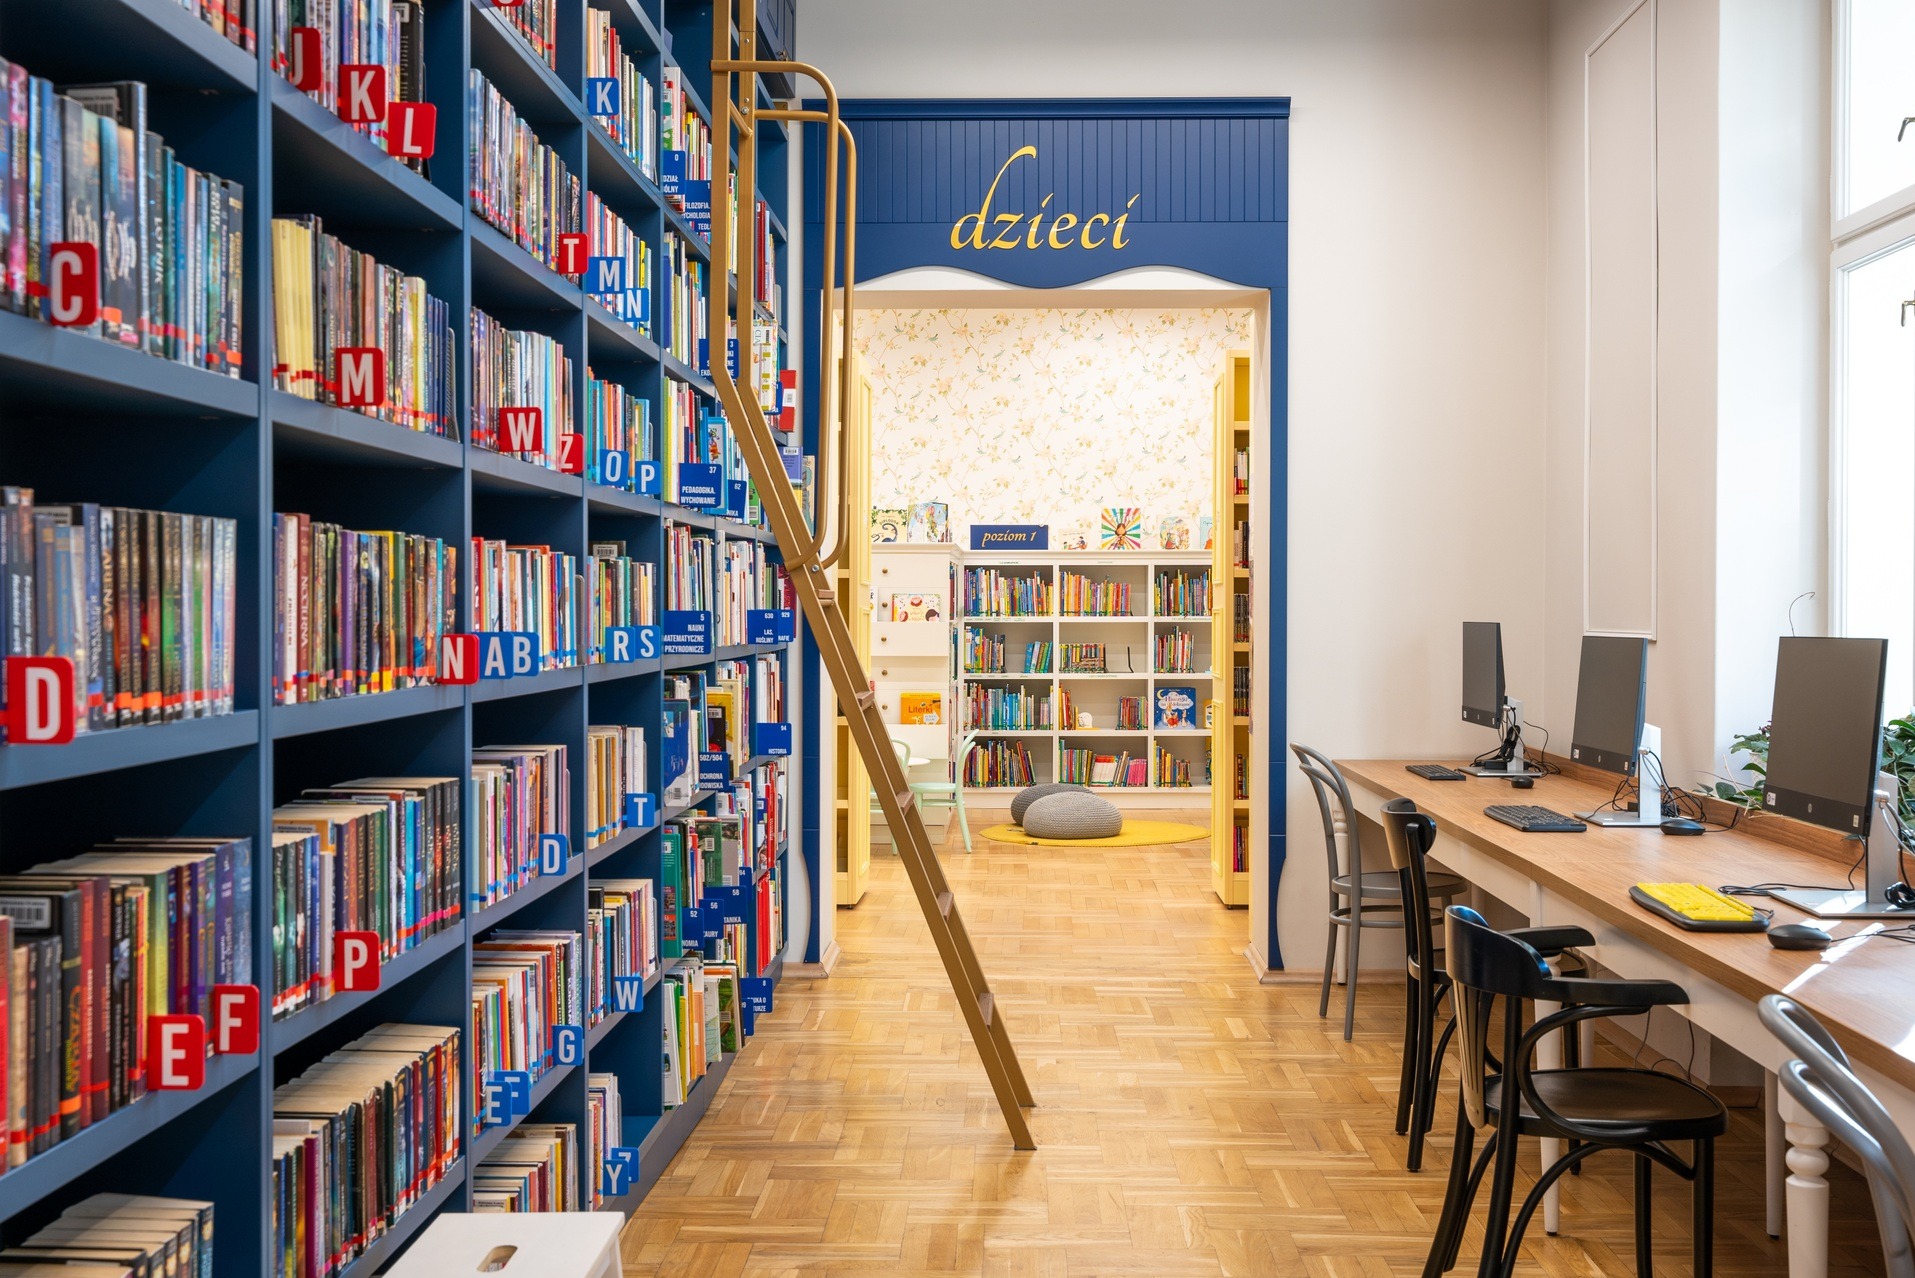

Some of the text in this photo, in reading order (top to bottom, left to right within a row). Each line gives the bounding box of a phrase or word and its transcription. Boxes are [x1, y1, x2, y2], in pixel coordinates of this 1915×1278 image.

[350, 70, 377, 121] K
[596, 81, 614, 114] K
[402, 107, 423, 155] L
[949, 145, 1141, 250] dzieci
[563, 238, 580, 272] T
[50, 250, 83, 323] C
[598, 260, 621, 292] M
[626, 289, 642, 318] N
[341, 353, 374, 403] M
[507, 412, 536, 451] W
[604, 451, 622, 482] O
[640, 464, 656, 493] P
[708, 466, 717, 474] 37
[680, 496, 716, 505] WYCHOWANIE
[981, 529, 1037, 548] poziom 1
[300, 576, 309, 647] NOCTURNA
[700, 613, 705, 622] 5
[640, 628, 655, 657] S
[687, 624, 705, 632] NAUKI
[443, 637, 464, 679] N
[485, 637, 507, 676] A
[512, 635, 532, 674] B
[613, 630, 630, 661] R
[665, 645, 705, 653] PRZYRODNICZE
[24, 666, 61, 741] D
[908, 705, 933, 714] Literki
[700, 772, 723, 780] OCHRONA
[633, 797, 648, 826] T
[543, 839, 560, 873] D
[689, 910, 698, 918] 52
[710, 902, 718, 910] 56
[343, 939, 368, 989] P
[615, 980, 639, 1011] W
[219, 993, 246, 1052] F
[160, 1023, 190, 1086] E
[558, 1030, 576, 1064] G
[485, 1086, 503, 1123] E
[605, 1164, 623, 1195] Y
